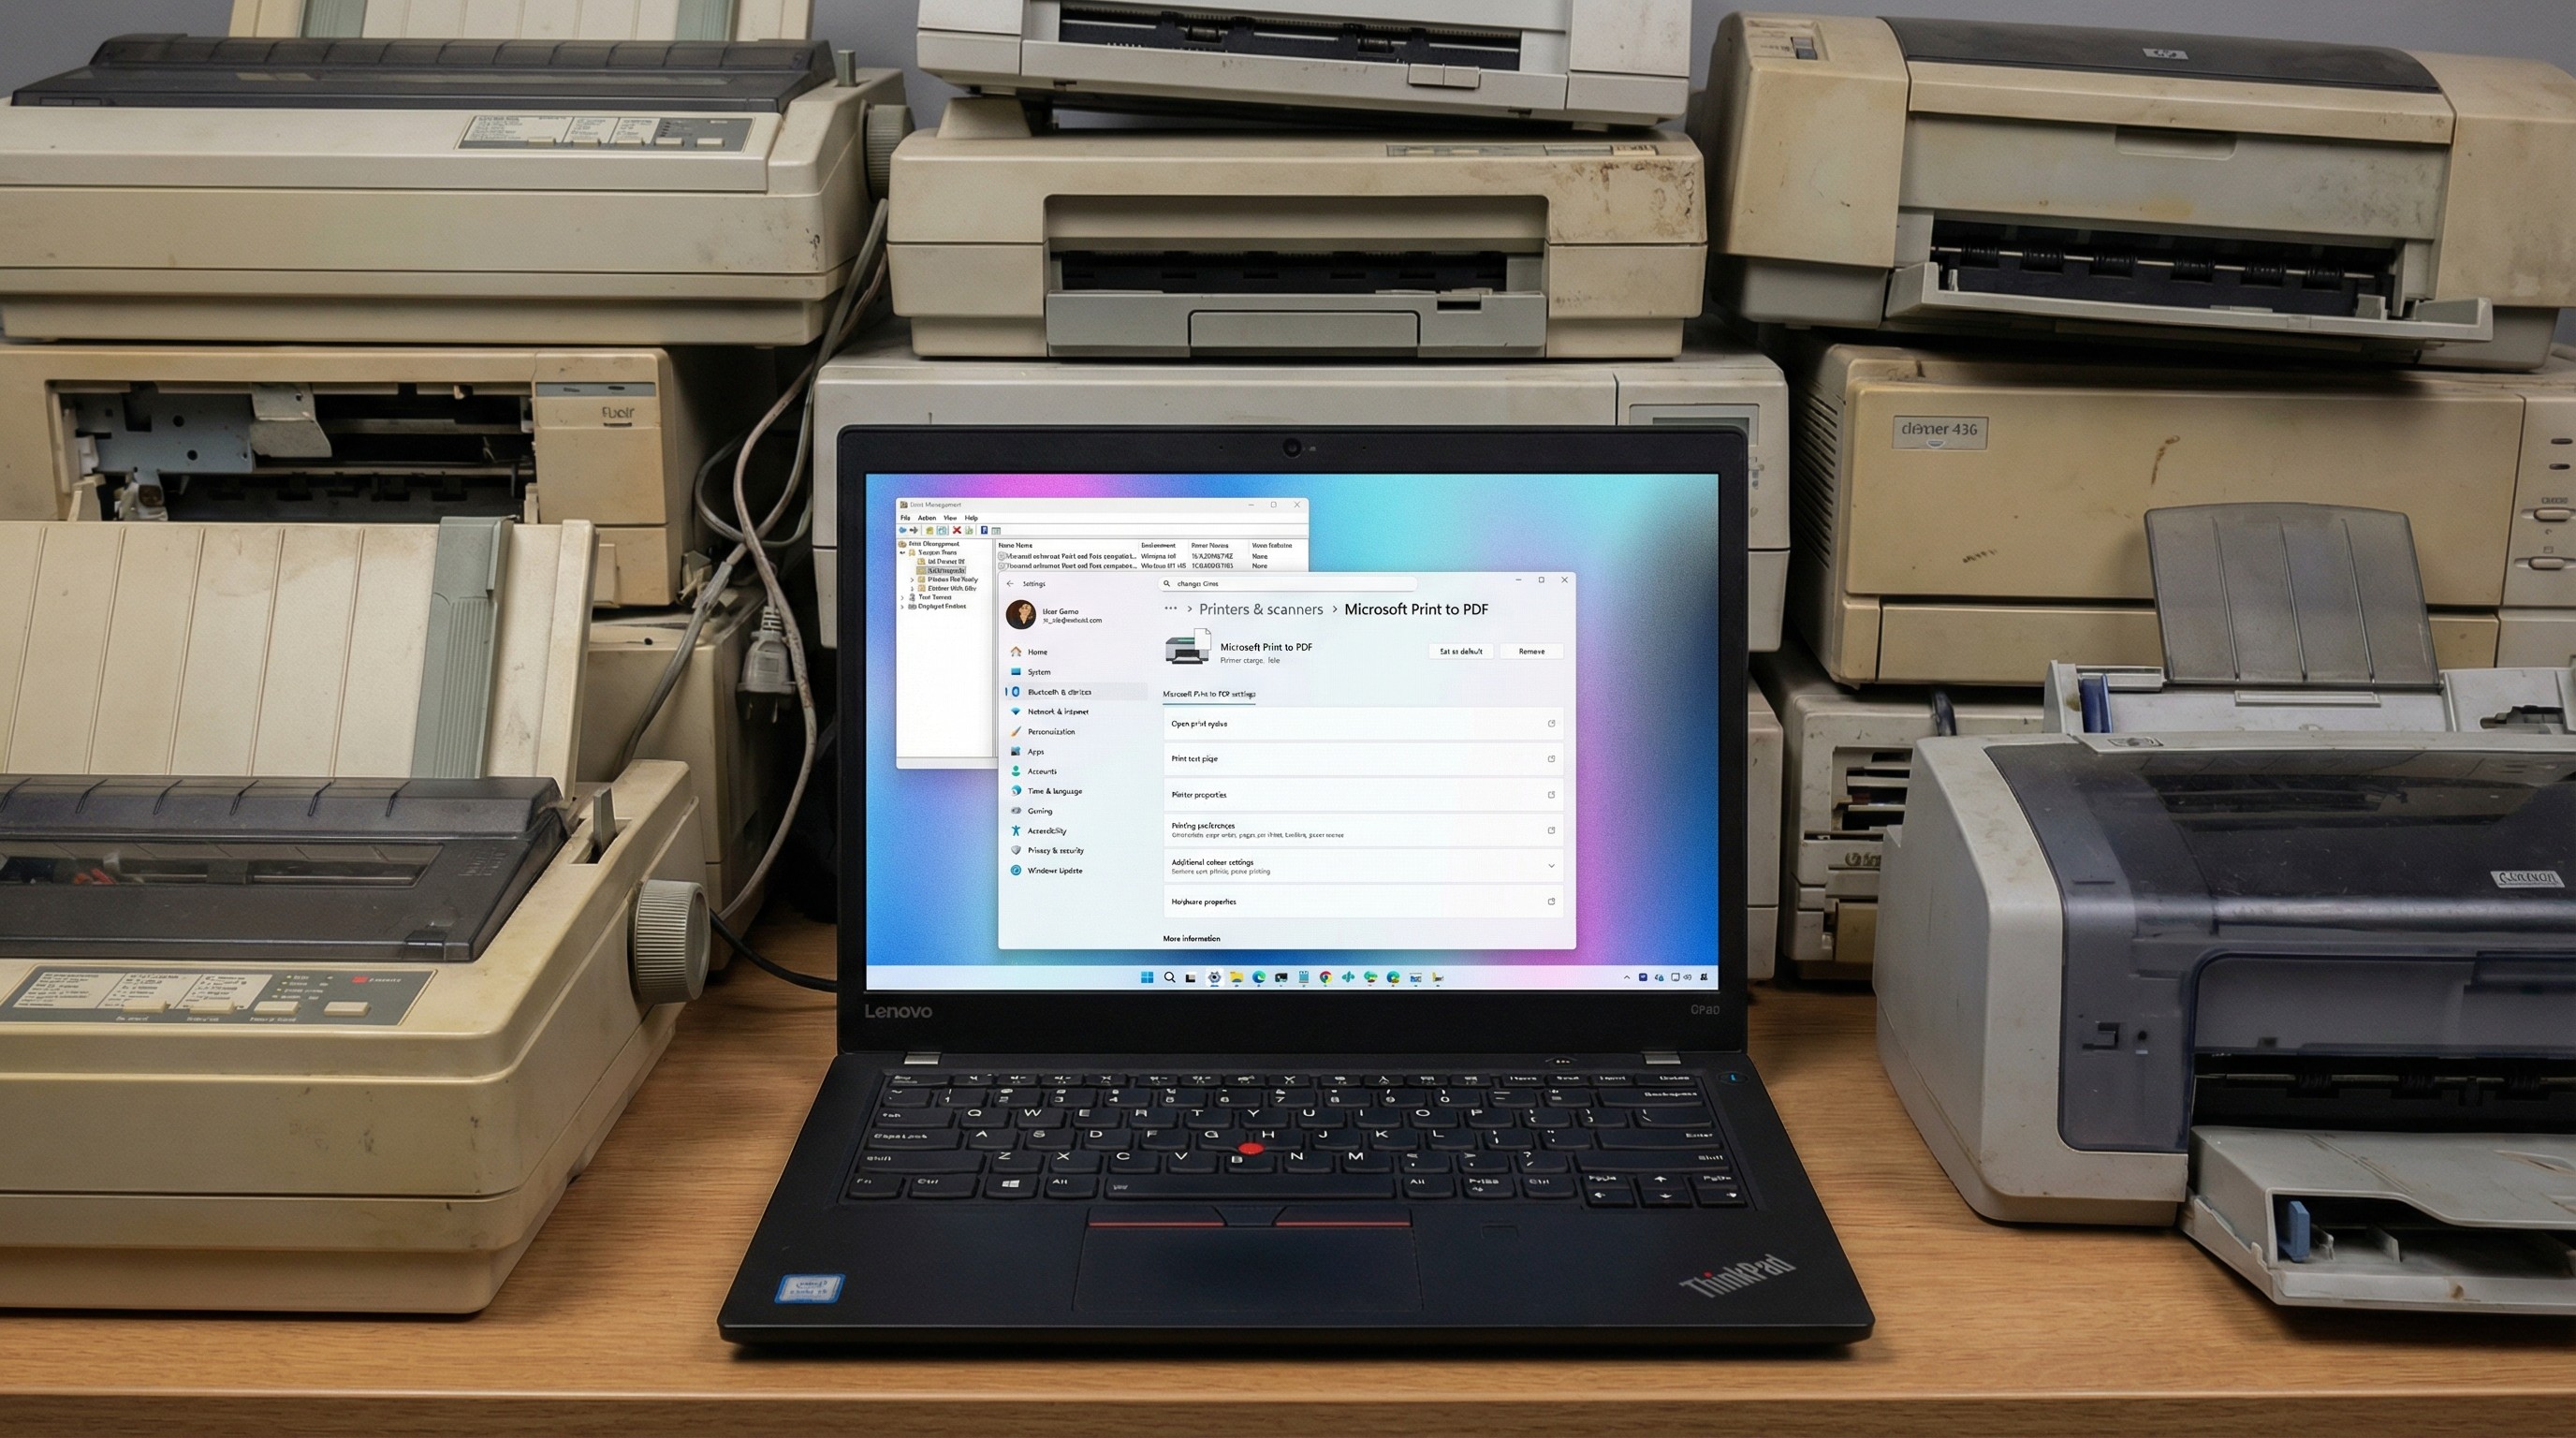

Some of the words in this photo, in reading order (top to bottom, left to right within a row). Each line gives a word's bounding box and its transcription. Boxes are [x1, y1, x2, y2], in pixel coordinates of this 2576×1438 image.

[1199, 603, 1250, 616] Printers
[1253, 603, 1264, 616] &
[1267, 606, 1324, 616] scanners
[1345, 603, 1408, 616] Microsoft
[1412, 603, 1442, 616] Print
[1446, 603, 1459, 616] to
[1463, 603, 1488, 616] PDF
[1263, 643, 1282, 652] Print
[1285, 643, 1294, 652] to
[1296, 643, 1312, 652] PDF
[865, 1004, 933, 1019] Lenovo
[998, 1152, 1011, 1160] Z
[1057, 1152, 1070, 1160] X
[1116, 1152, 1130, 1160] C
[1175, 1152, 1188, 1160] V
[1291, 1152, 1304, 1160] N
[1349, 1152, 1364, 1160] M
[1678, 1253, 1796, 1298] ThinkPad
